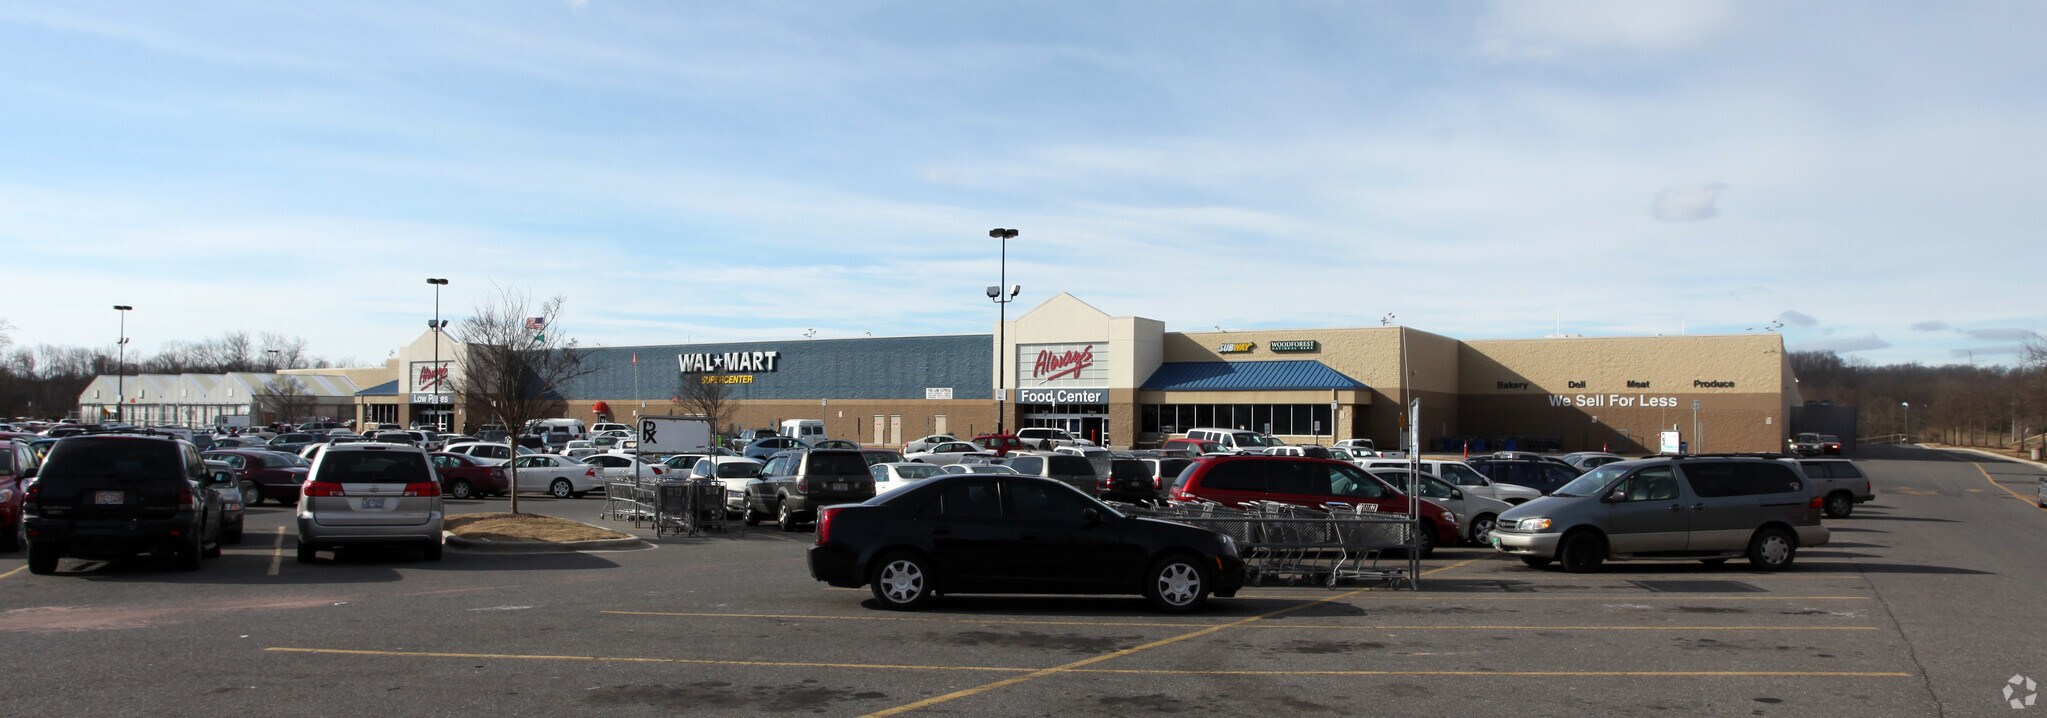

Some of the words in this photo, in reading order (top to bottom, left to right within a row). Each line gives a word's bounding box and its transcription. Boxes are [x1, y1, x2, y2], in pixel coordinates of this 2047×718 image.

[1218, 342, 1253, 352] SUBWAY
[1033, 344, 1093, 379] Always
[701, 375, 753, 384] SUPERCENTER
[1497, 381, 1528, 390] Bakery
[1627, 380, 1650, 388] Meat
[1694, 380, 1735, 388] Produce
[1021, 390, 1054, 402] Food
[1057, 390, 1101, 403] Center
[1548, 394, 1571, 407] We
[1576, 394, 1604, 407] Sell
[1609, 394, 1635, 407] For
[1640, 394, 1678, 407] Less
